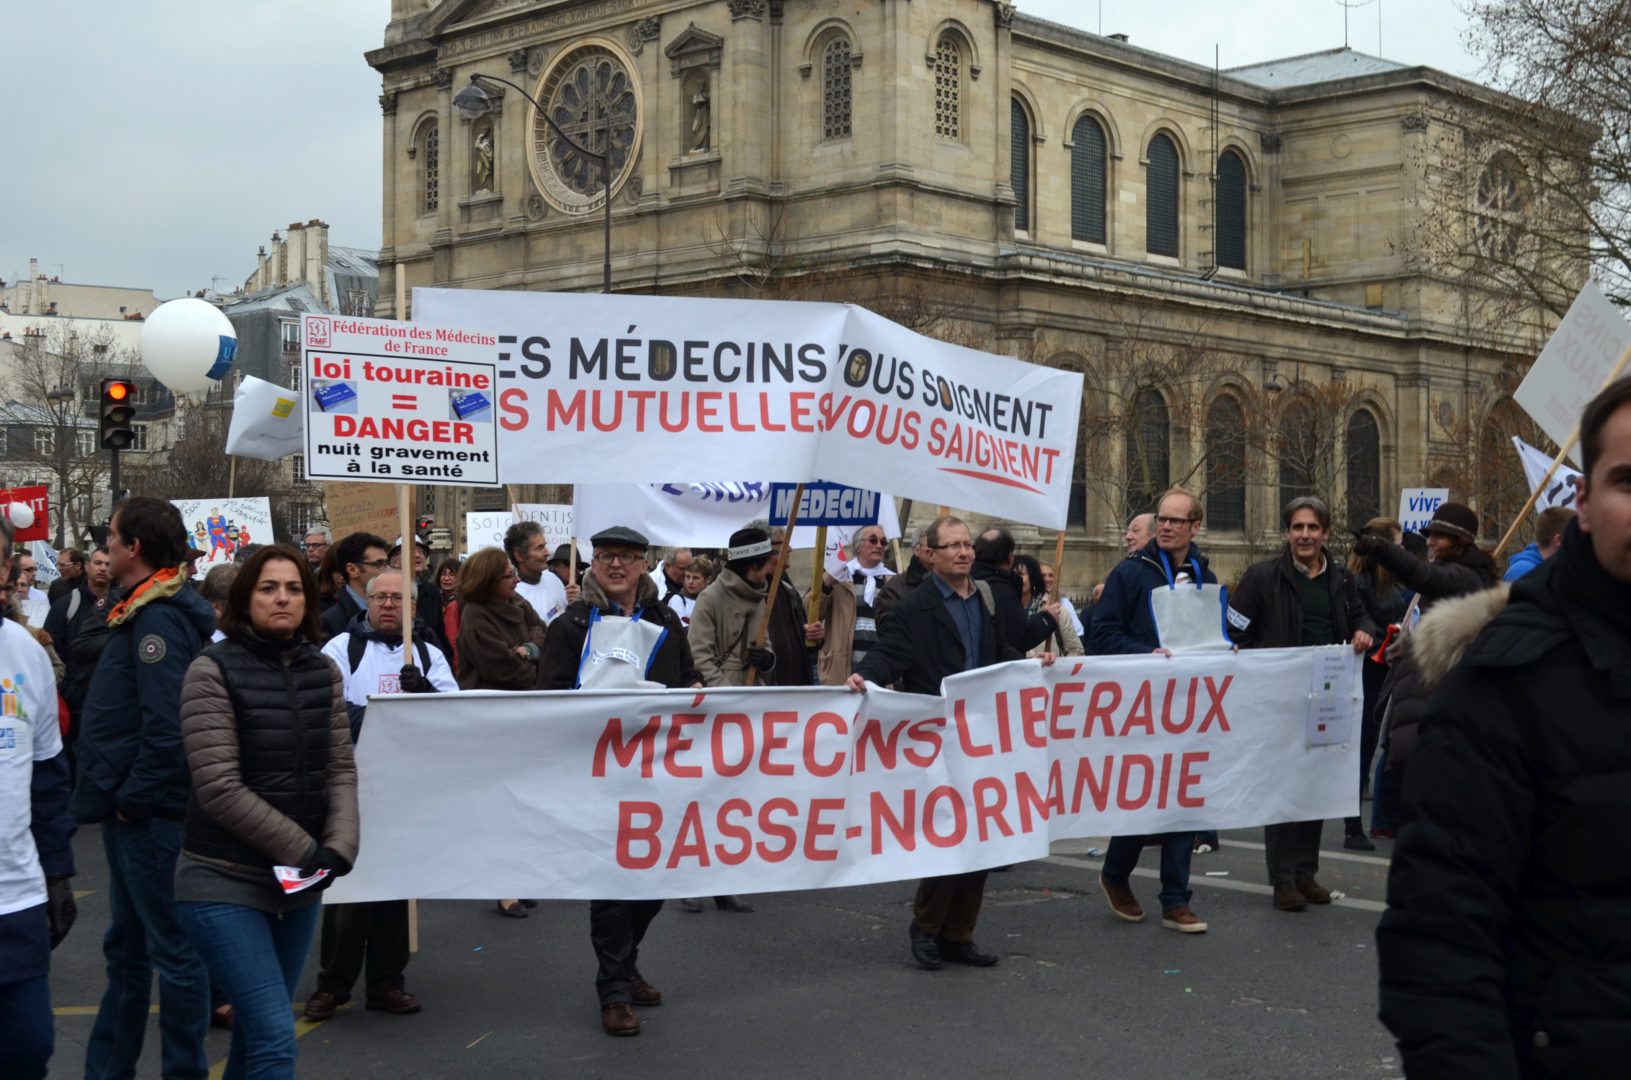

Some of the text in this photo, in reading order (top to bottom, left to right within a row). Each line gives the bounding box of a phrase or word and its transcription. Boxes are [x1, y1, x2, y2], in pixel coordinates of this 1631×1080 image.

[309, 337, 327, 345] FMF
[333, 320, 496, 346] Fédération des Médecins
[384, 340, 448, 356] de France
[313, 357, 489, 389] loi touraine
[499, 335, 551, 380] ES
[568, 324, 827, 384] MÉDECINS
[922, 369, 1053, 439] SOIGNENT
[333, 415, 474, 444] DANGER
[825, 394, 922, 451] VOUS
[927, 417, 1060, 485] SAIGNENT
[318, 443, 489, 463] nuit gravement
[347, 459, 463, 477] à la santé
[1409, 491, 1441, 512] VIVE
[472, 517, 511, 530] SOIG
[520, 510, 573, 523] DENTIS
[592, 663, 1234, 778] MÉDECNS LIBÉRAUX
[615, 751, 1209, 869] BASSE-NORMANDIE
